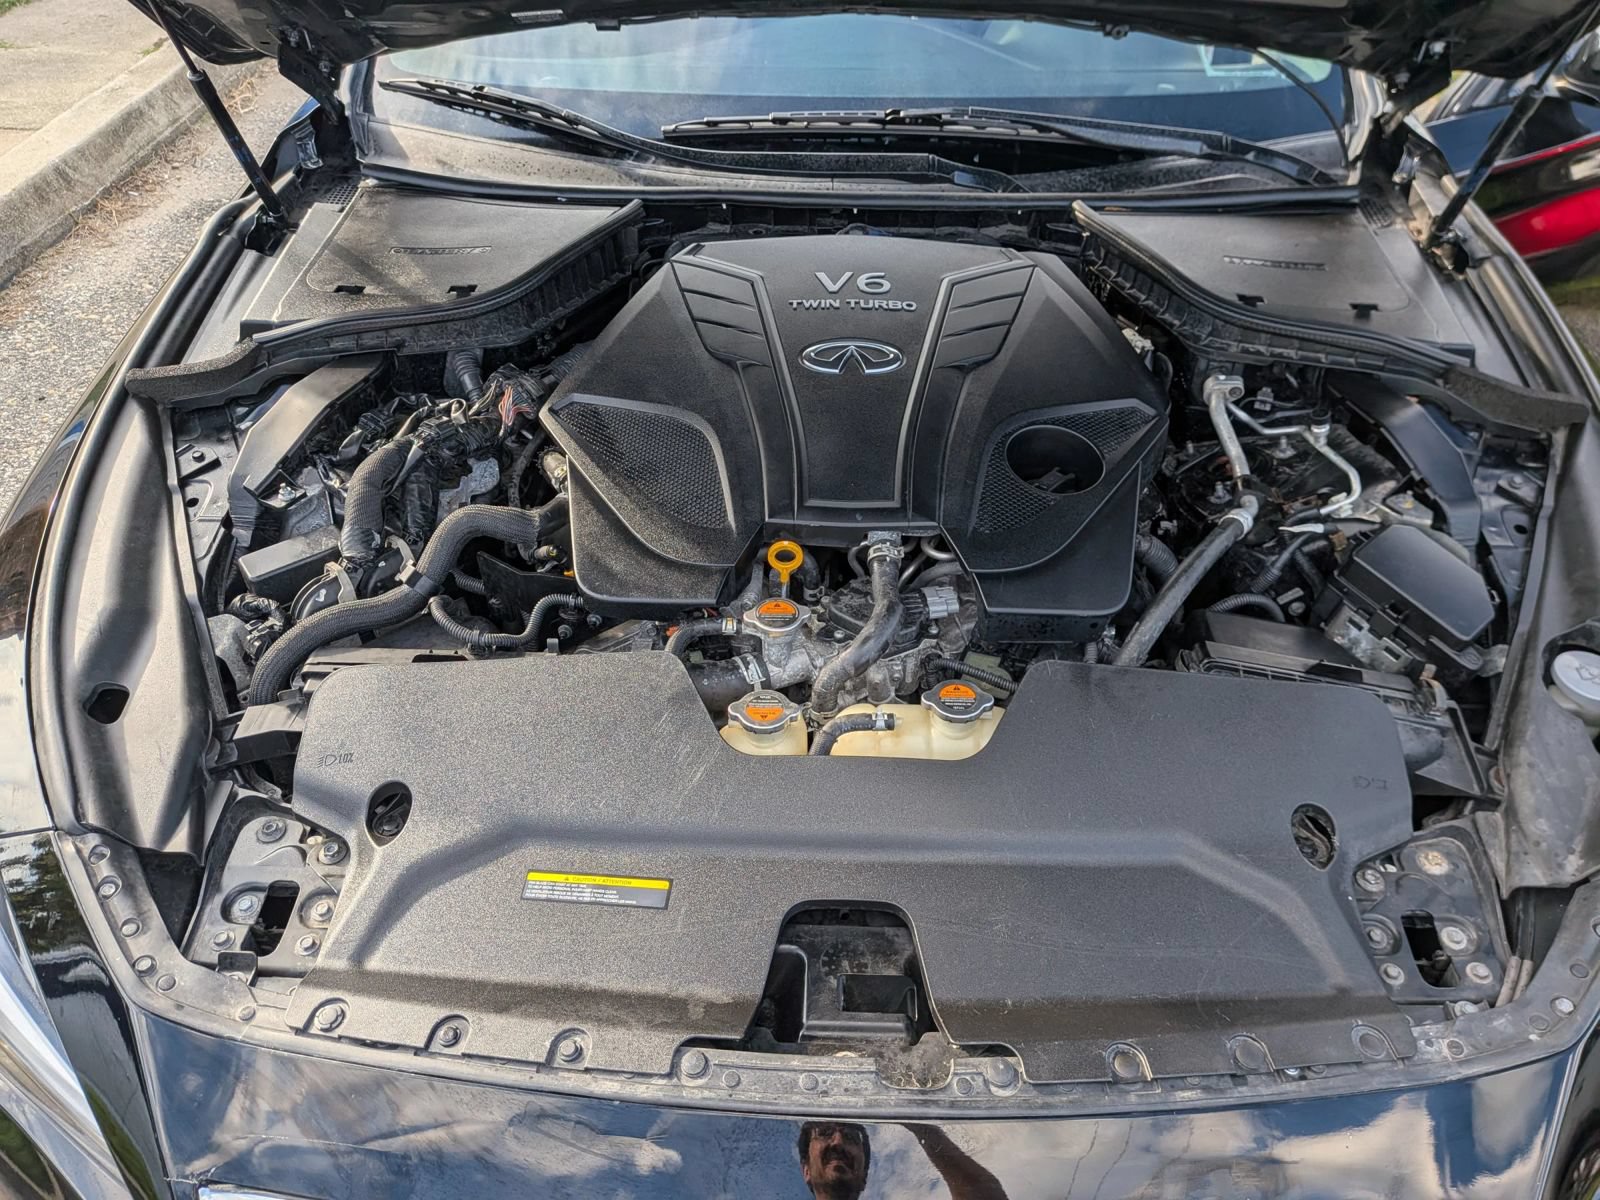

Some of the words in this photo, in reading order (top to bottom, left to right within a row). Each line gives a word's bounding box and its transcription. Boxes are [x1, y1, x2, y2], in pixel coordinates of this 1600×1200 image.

[814, 271, 892, 295] V6
[788, 299, 840, 310] TWIN
[846, 299, 917, 312] TURBO
[602, 878, 633, 886] ATTENTION
